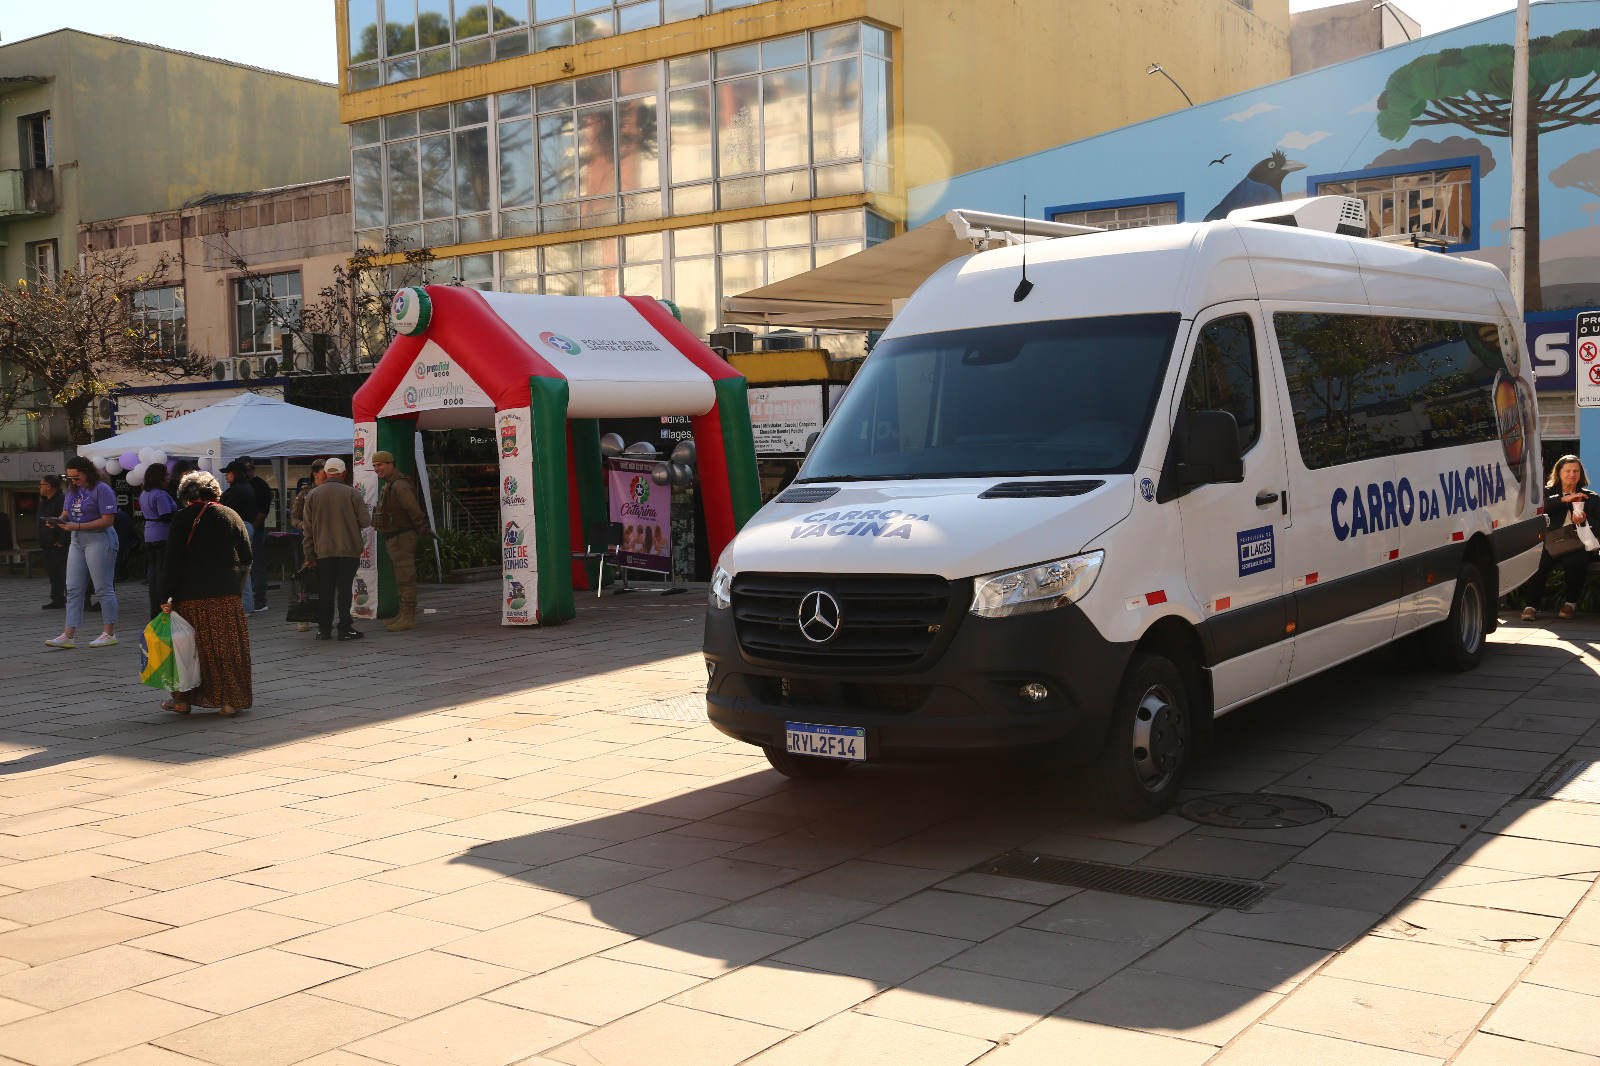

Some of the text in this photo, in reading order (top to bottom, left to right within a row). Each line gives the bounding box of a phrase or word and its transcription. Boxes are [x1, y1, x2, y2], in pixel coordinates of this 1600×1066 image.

[620, 344, 662, 352] CATARINA
[32, 458, 56, 473] Ótica
[1331, 461, 1506, 542] CARRO DA VACINA
[620, 502, 658, 519] Catarina
[803, 509, 930, 523] CARRO DA
[790, 521, 913, 540] VACINA
[517, 545, 528, 558] DE
[1250, 541, 1271, 557] LAGES
[792, 732, 857, 757] RYL2F14
